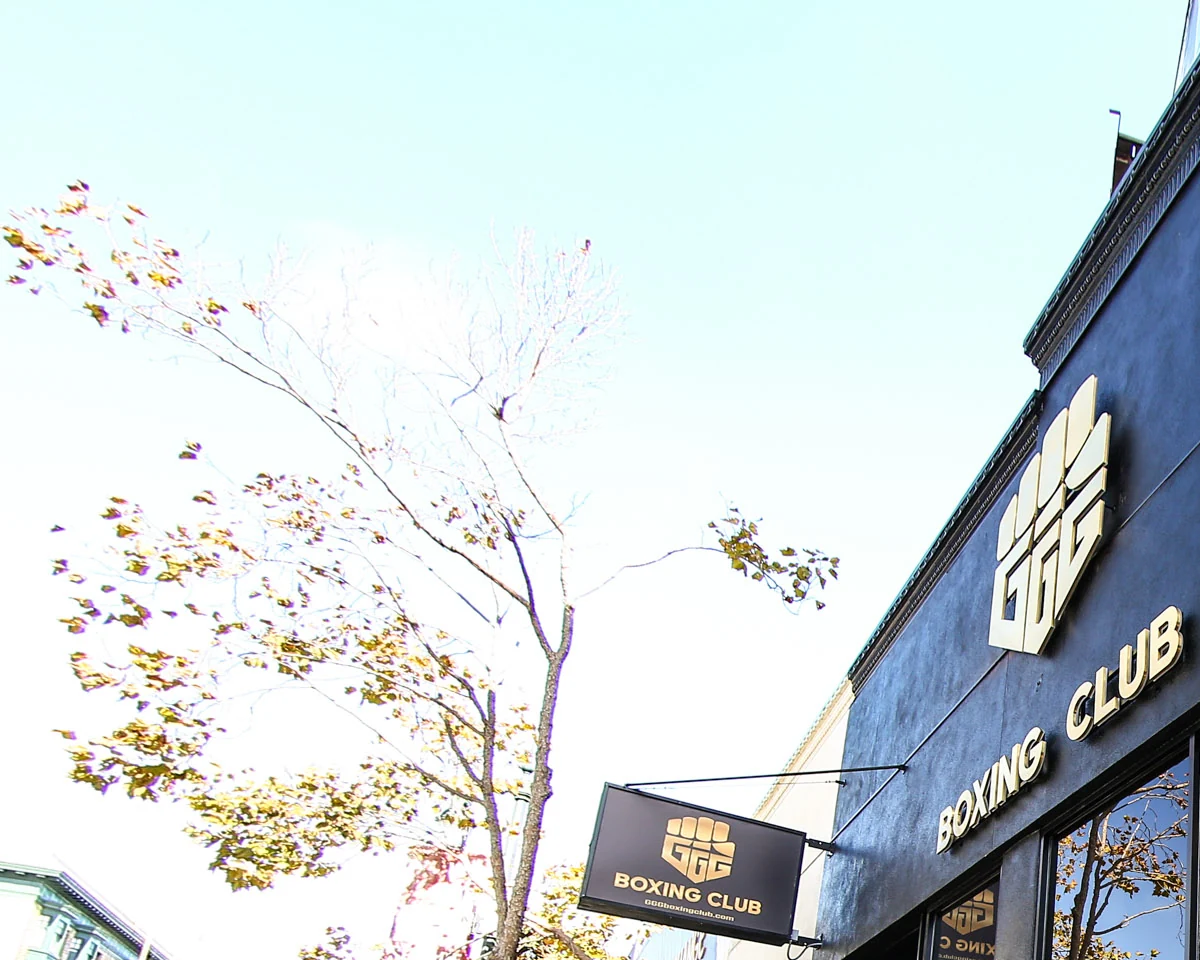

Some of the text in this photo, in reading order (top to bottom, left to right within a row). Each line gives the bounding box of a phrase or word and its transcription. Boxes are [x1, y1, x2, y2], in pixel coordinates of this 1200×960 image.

[937, 605, 1183, 855] BOXING CLUB
[661, 834, 736, 884] GGG
[614, 872, 762, 916] BOXING CLUB
[644, 899, 735, 922] GGGboxingclub.com
